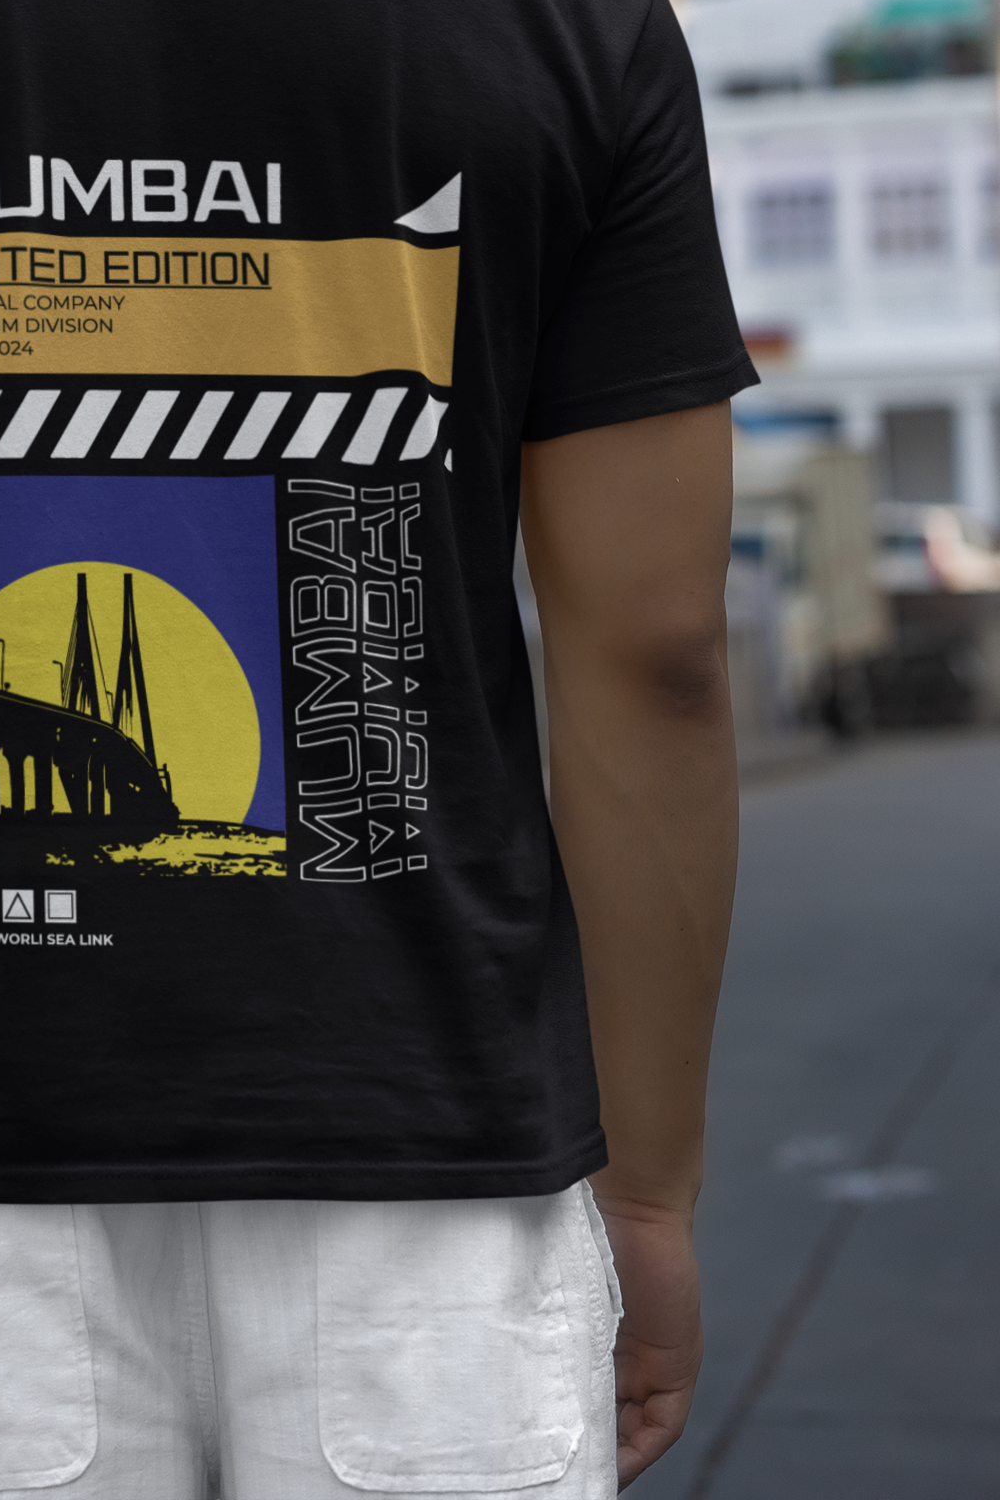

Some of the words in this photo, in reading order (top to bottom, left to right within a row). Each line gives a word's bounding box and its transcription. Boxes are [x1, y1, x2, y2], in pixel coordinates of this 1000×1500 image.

[103, 250, 271, 287] EDITION
[23, 294, 125, 311] COMPANY
[25, 318, 113, 334] DIVISION
[288, 479, 366, 882] MUMBAI
[46, 933, 76, 946] SEA
[79, 933, 114, 946] LINK
